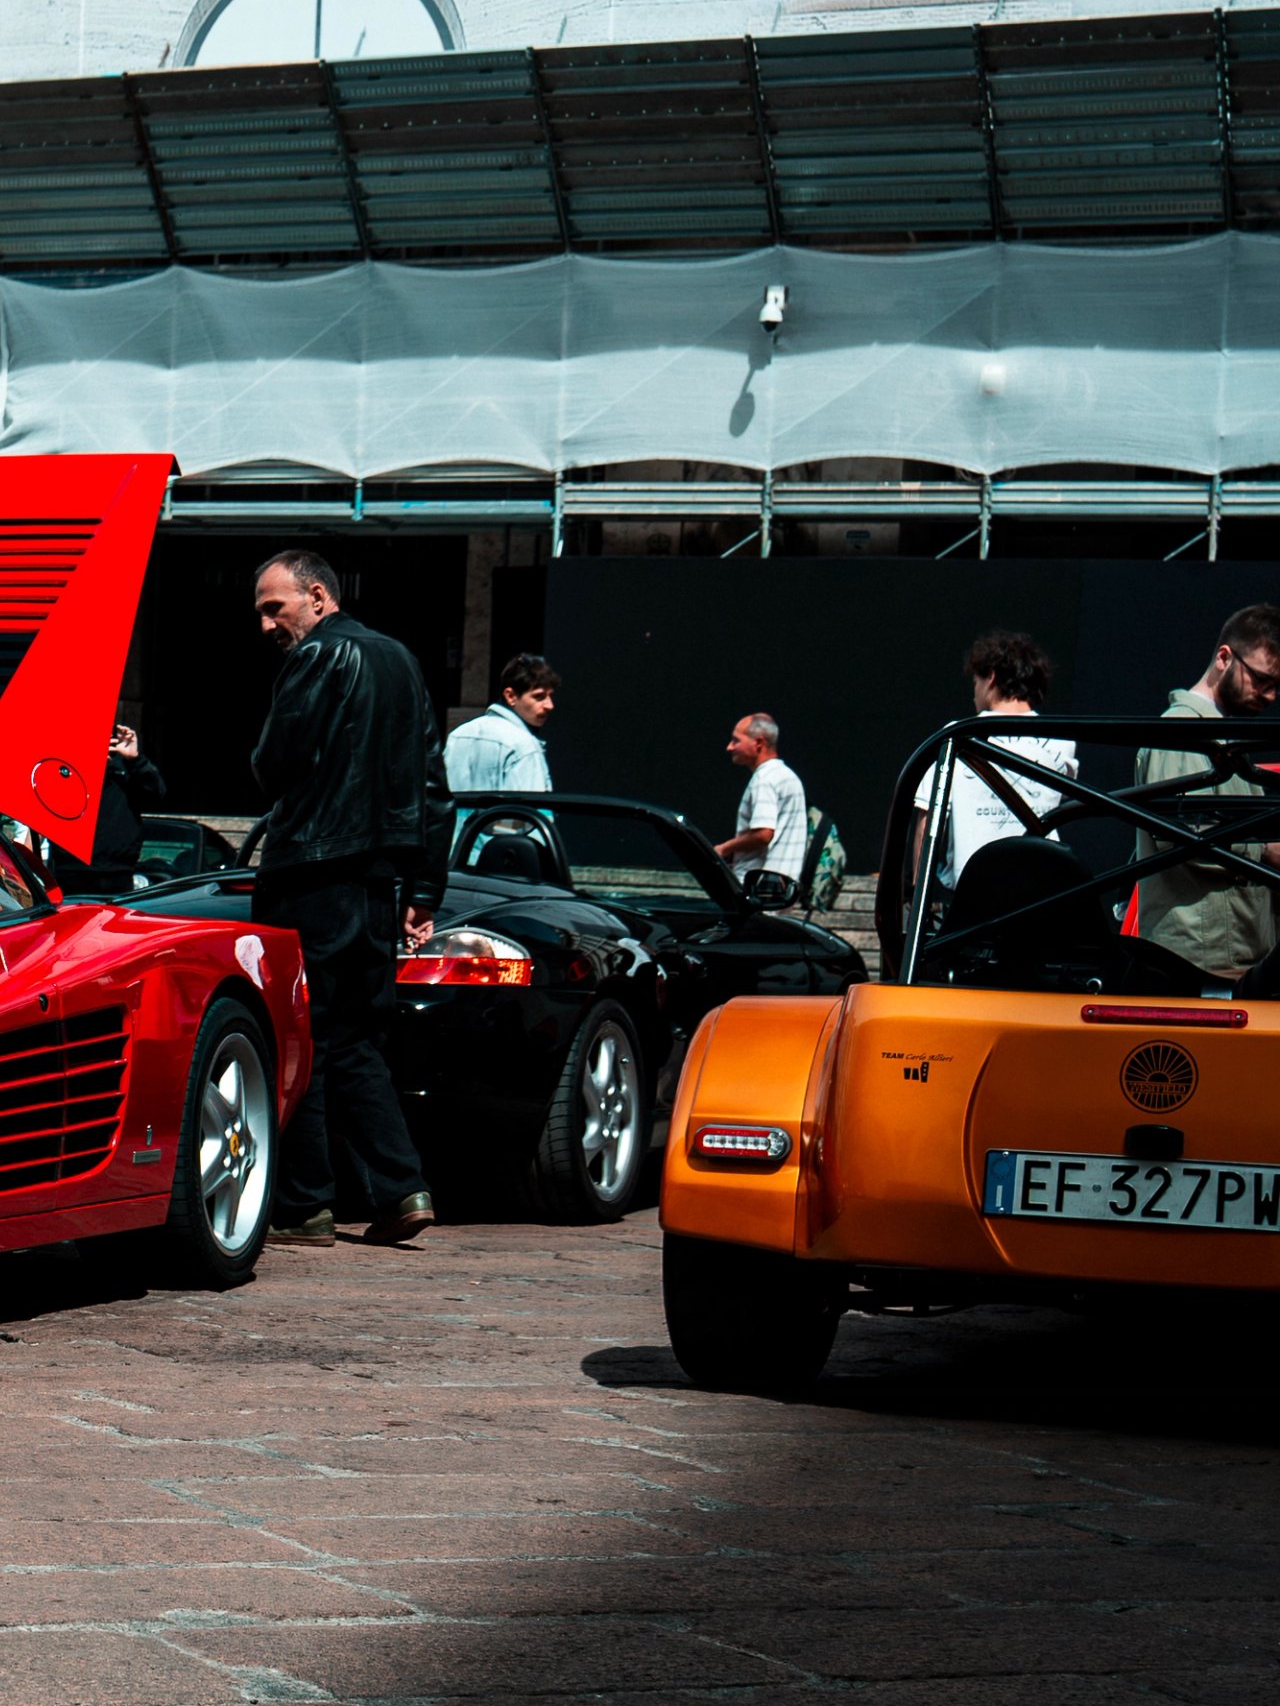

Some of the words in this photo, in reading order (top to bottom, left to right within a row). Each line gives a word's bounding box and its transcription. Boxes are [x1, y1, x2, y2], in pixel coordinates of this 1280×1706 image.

[881, 1051, 905, 1060] TEAM
[1129, 1083, 1186, 1093] WESTFIELD
[1020, 1159, 1086, 1213] EF
[1108, 1164, 1280, 1226] 327PW
